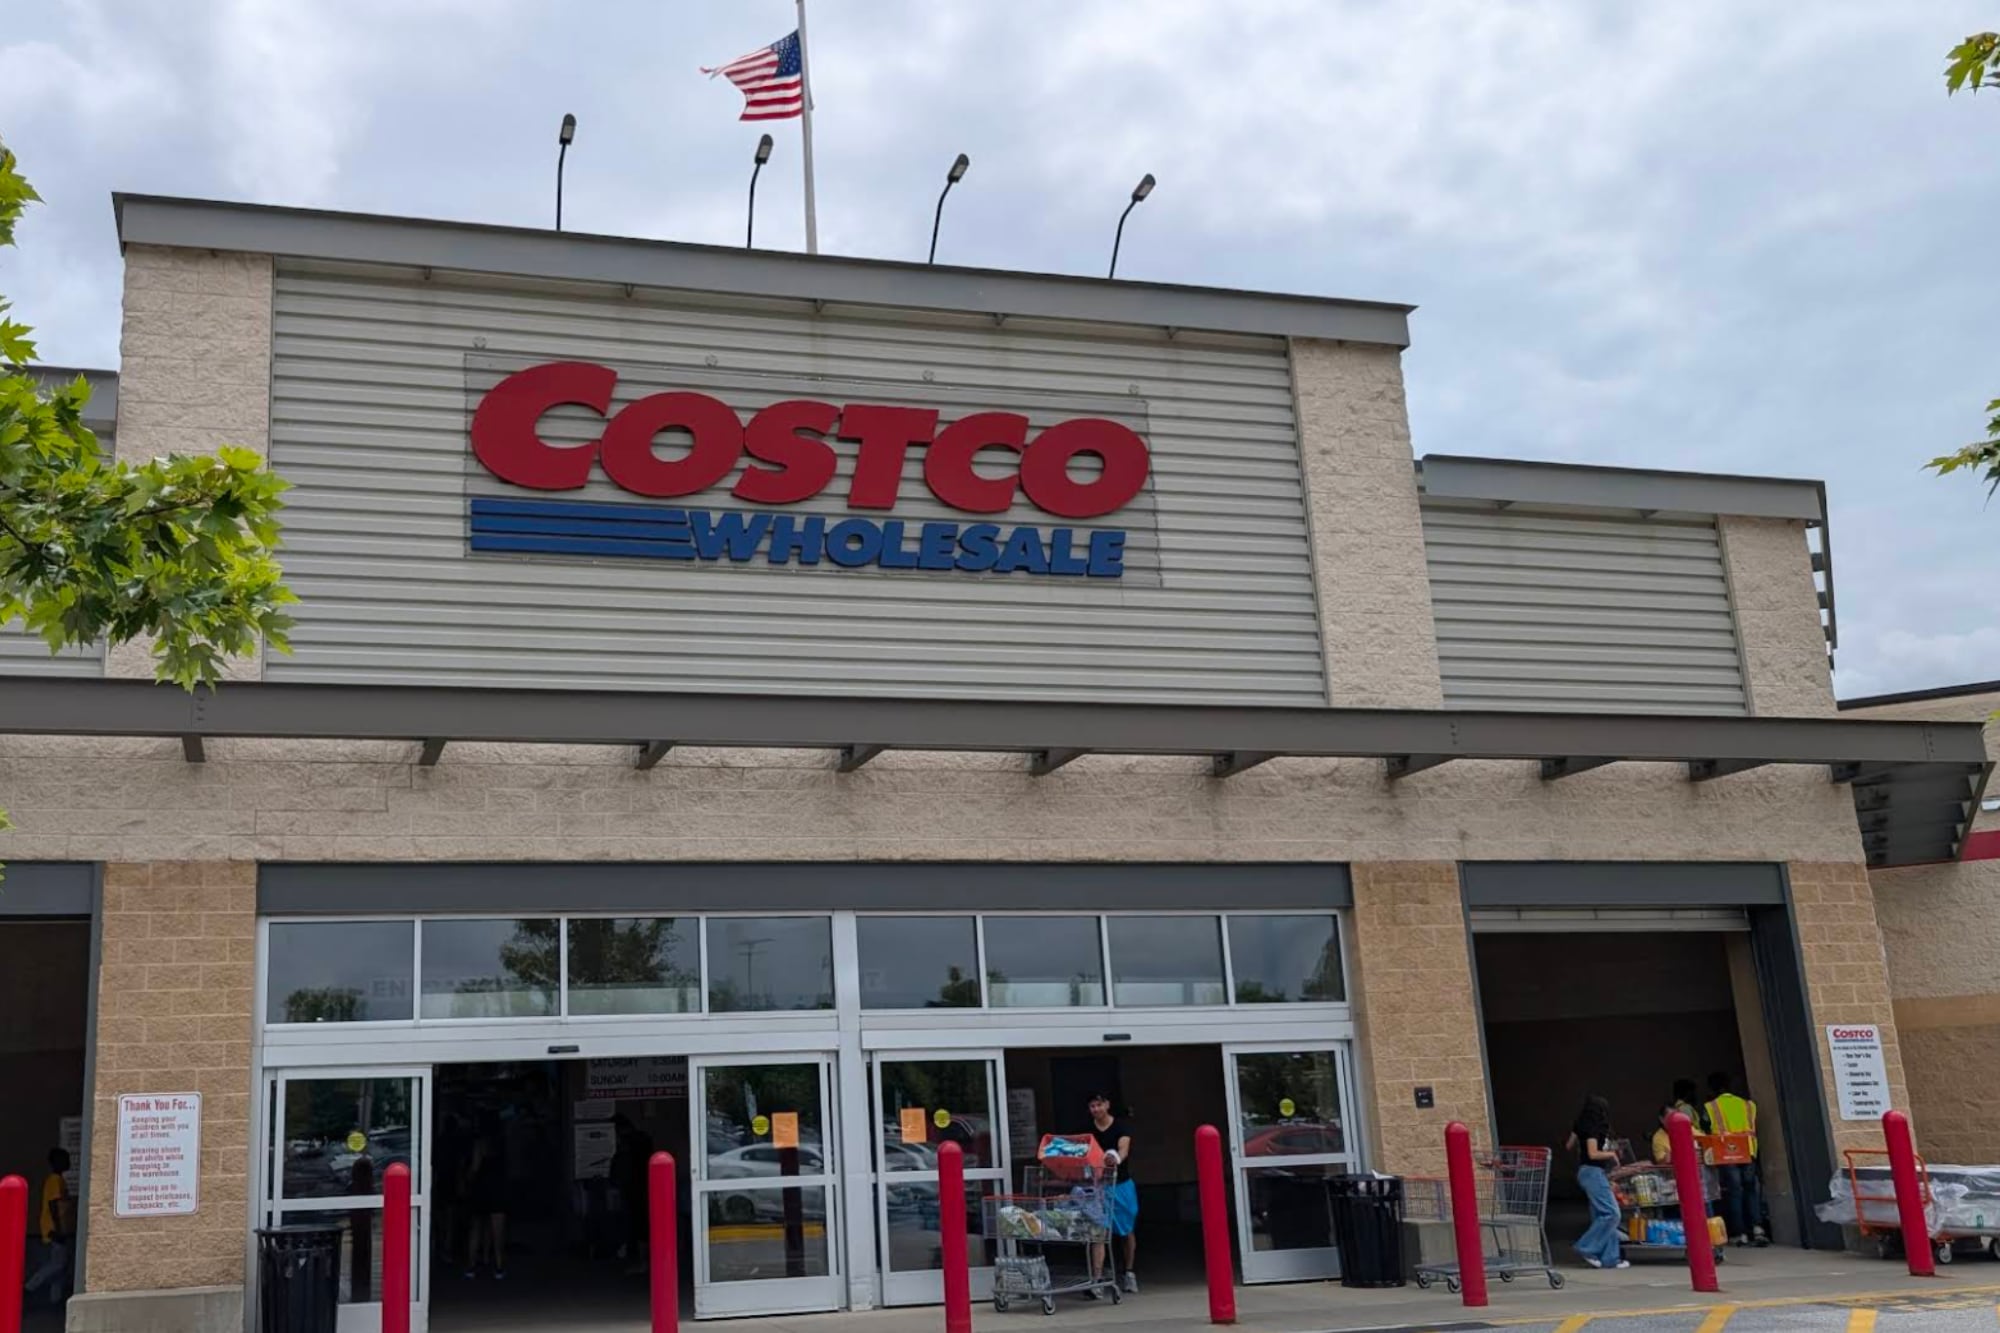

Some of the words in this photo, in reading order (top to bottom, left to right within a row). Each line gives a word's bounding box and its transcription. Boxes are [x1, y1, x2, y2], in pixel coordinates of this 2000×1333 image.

[471, 361, 1150, 519] COSTCO
[689, 511, 1126, 577] WHOLESALE
[1833, 1028, 1873, 1038] COSTCO
[591, 1074, 628, 1085] SUNDAY
[124, 1099, 151, 1111] Thank
[154, 1098, 170, 1110] You
[131, 1123, 159, 1131] children
[177, 1123, 189, 1131] you
[129, 1163, 161, 1171] shopping
